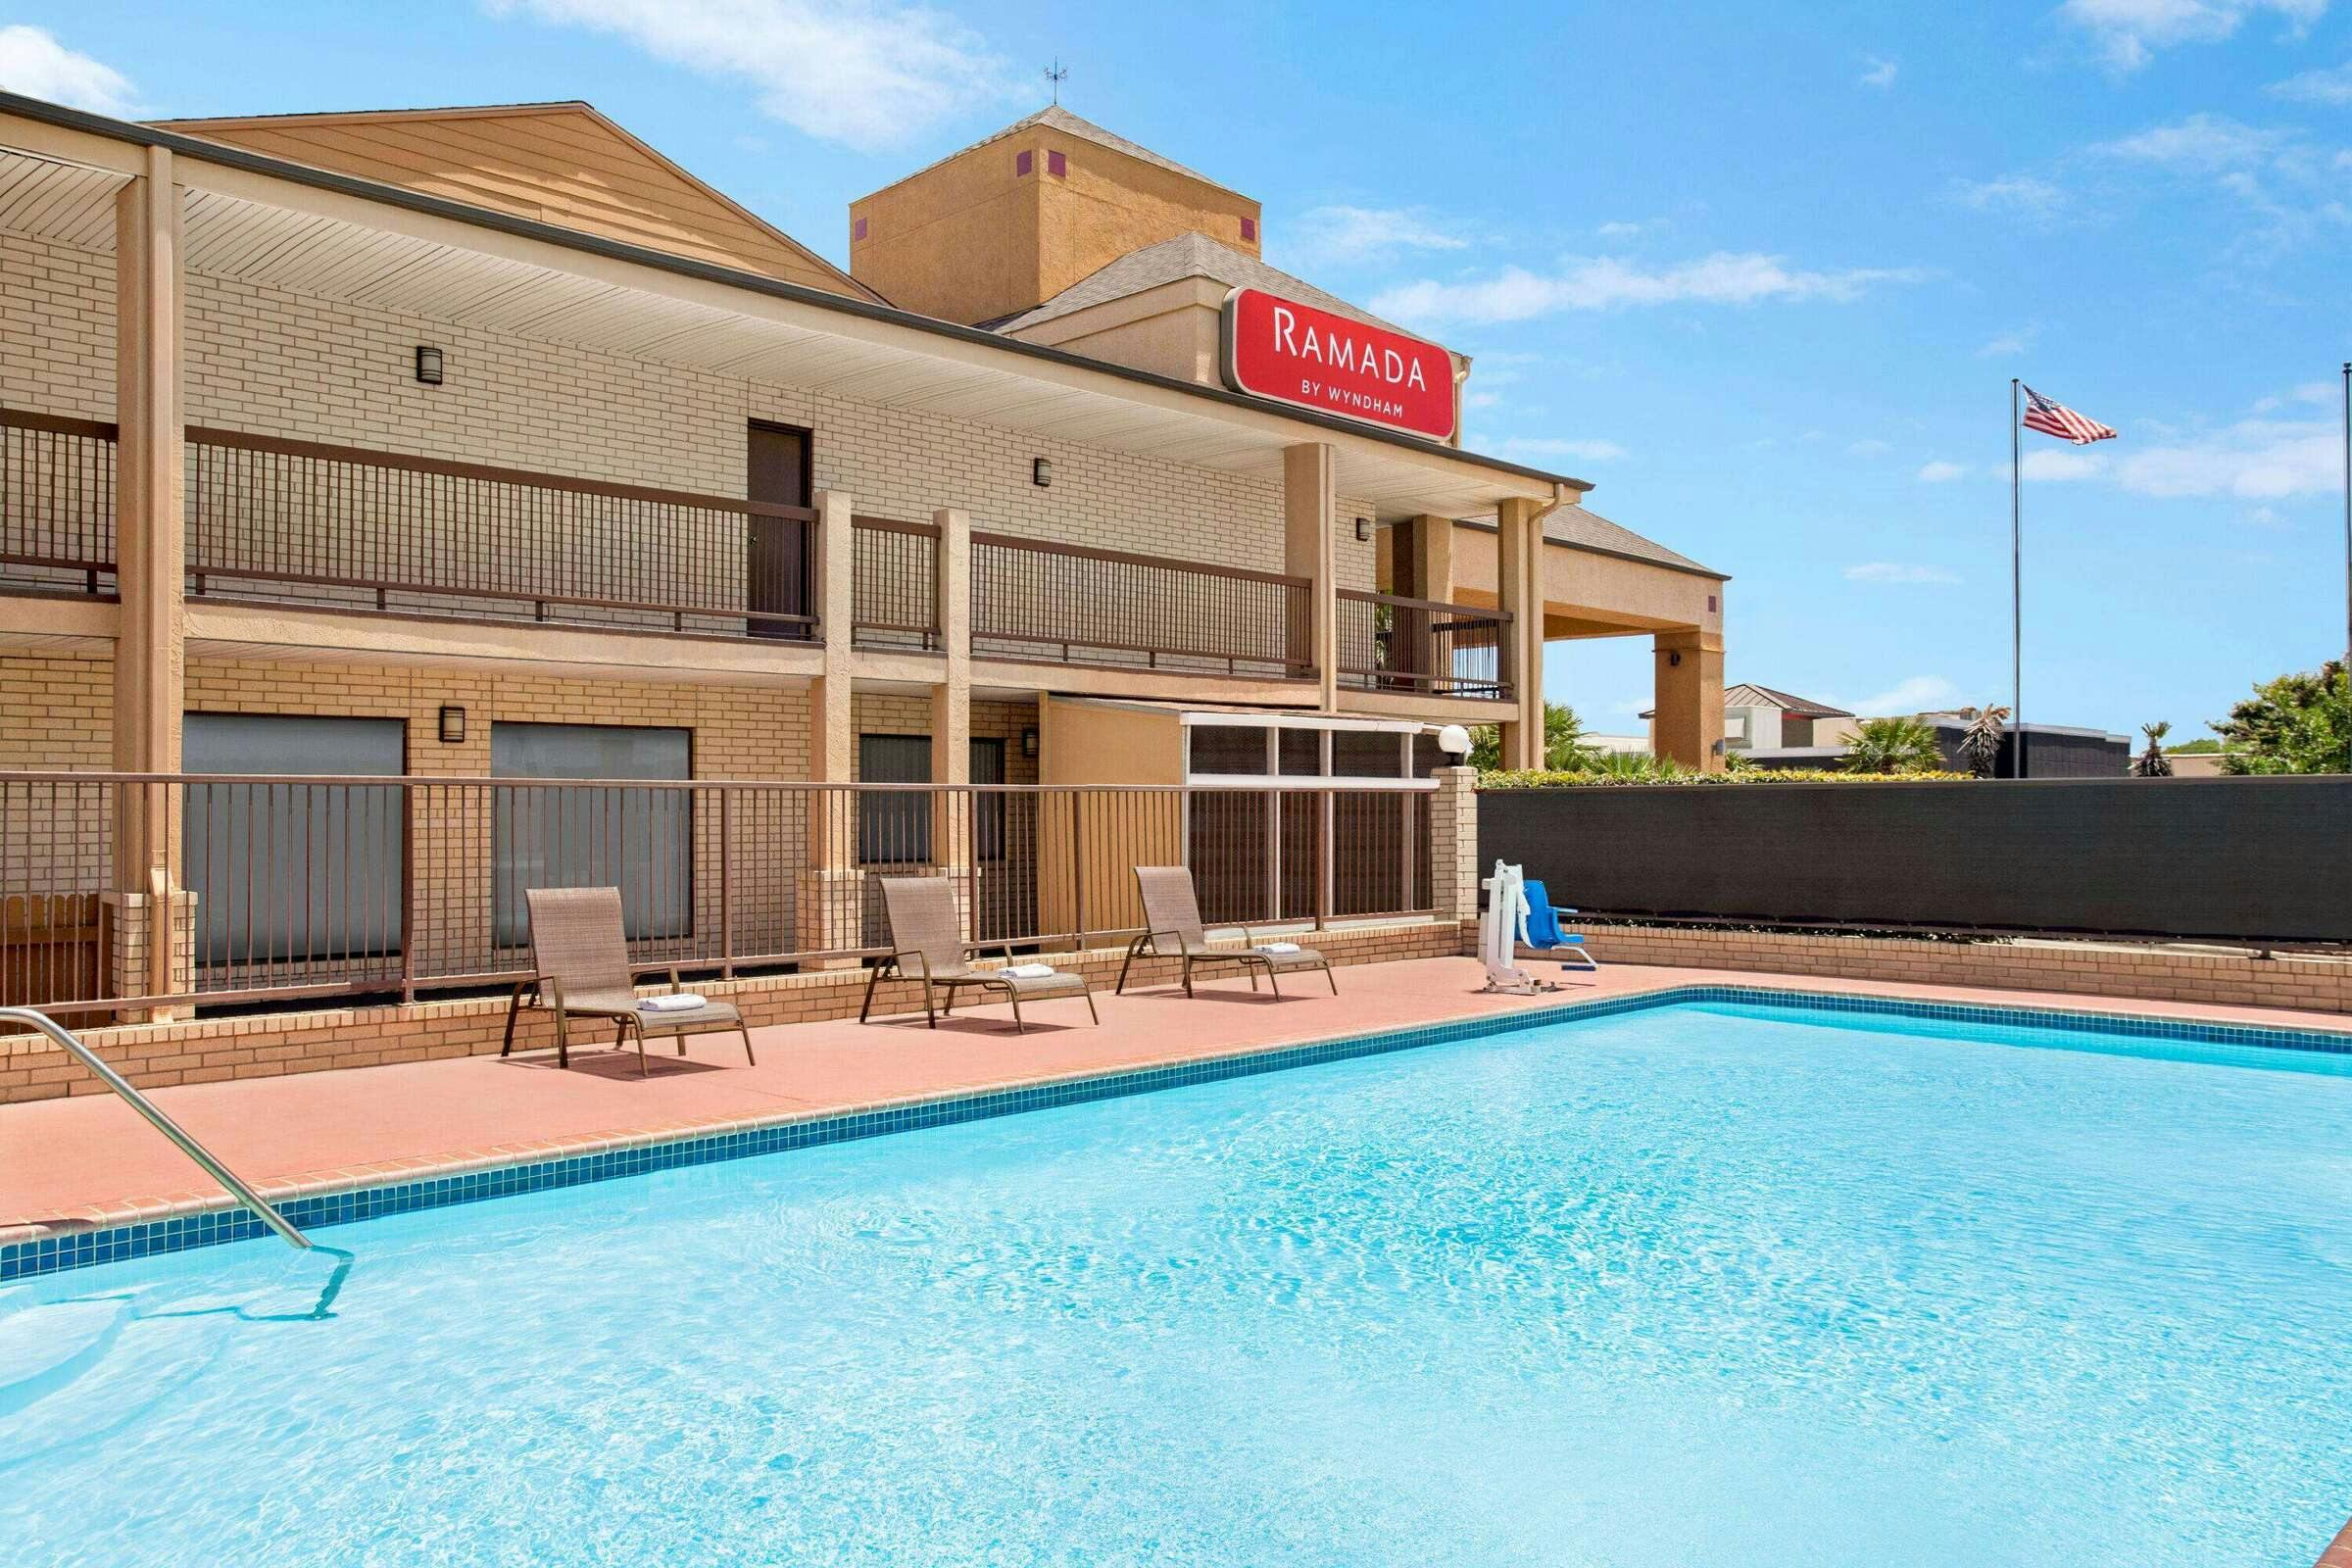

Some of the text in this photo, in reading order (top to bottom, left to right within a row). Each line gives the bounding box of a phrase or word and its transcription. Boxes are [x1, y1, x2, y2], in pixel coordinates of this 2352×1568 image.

[1274, 306, 1426, 392] RAMADA
[1301, 379, 1402, 417] BY WYNDHAM
